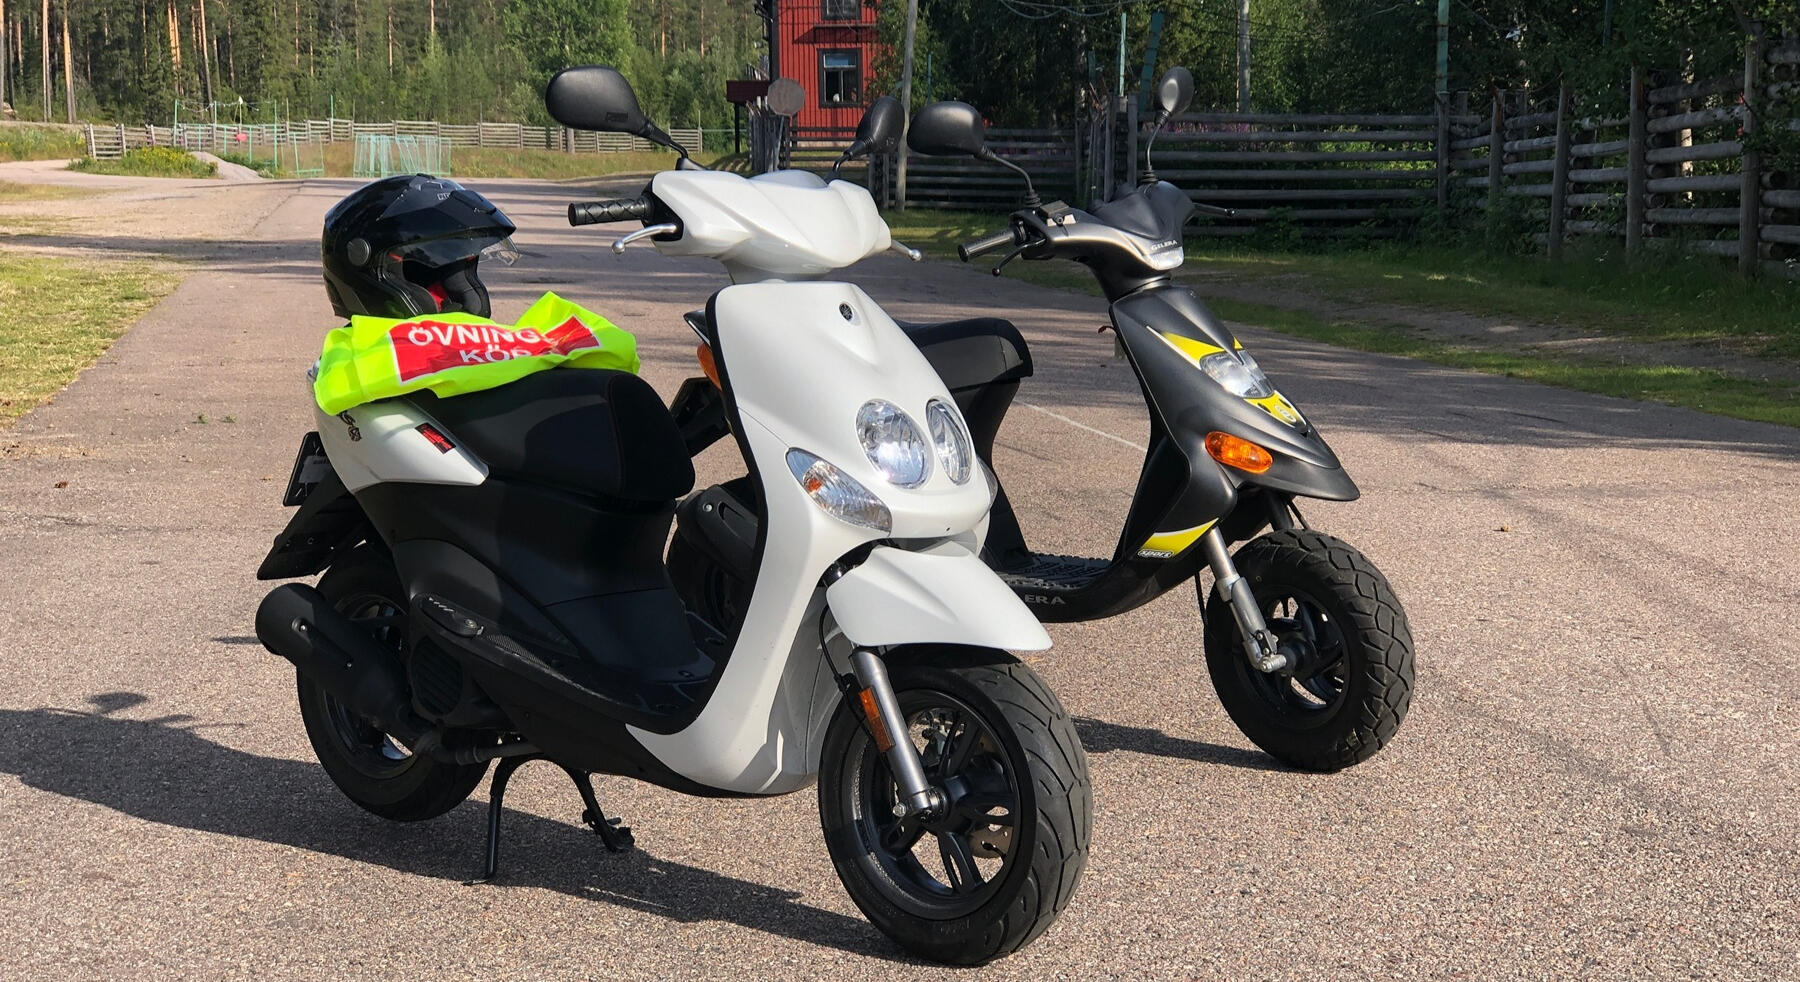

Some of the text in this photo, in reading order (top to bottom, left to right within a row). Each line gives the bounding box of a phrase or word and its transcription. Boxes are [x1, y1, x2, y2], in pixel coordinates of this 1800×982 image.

[1151, 239, 1178, 251] GILERA
[408, 325, 543, 346] ÖVNING
[1024, 594, 1066, 605] ERA
